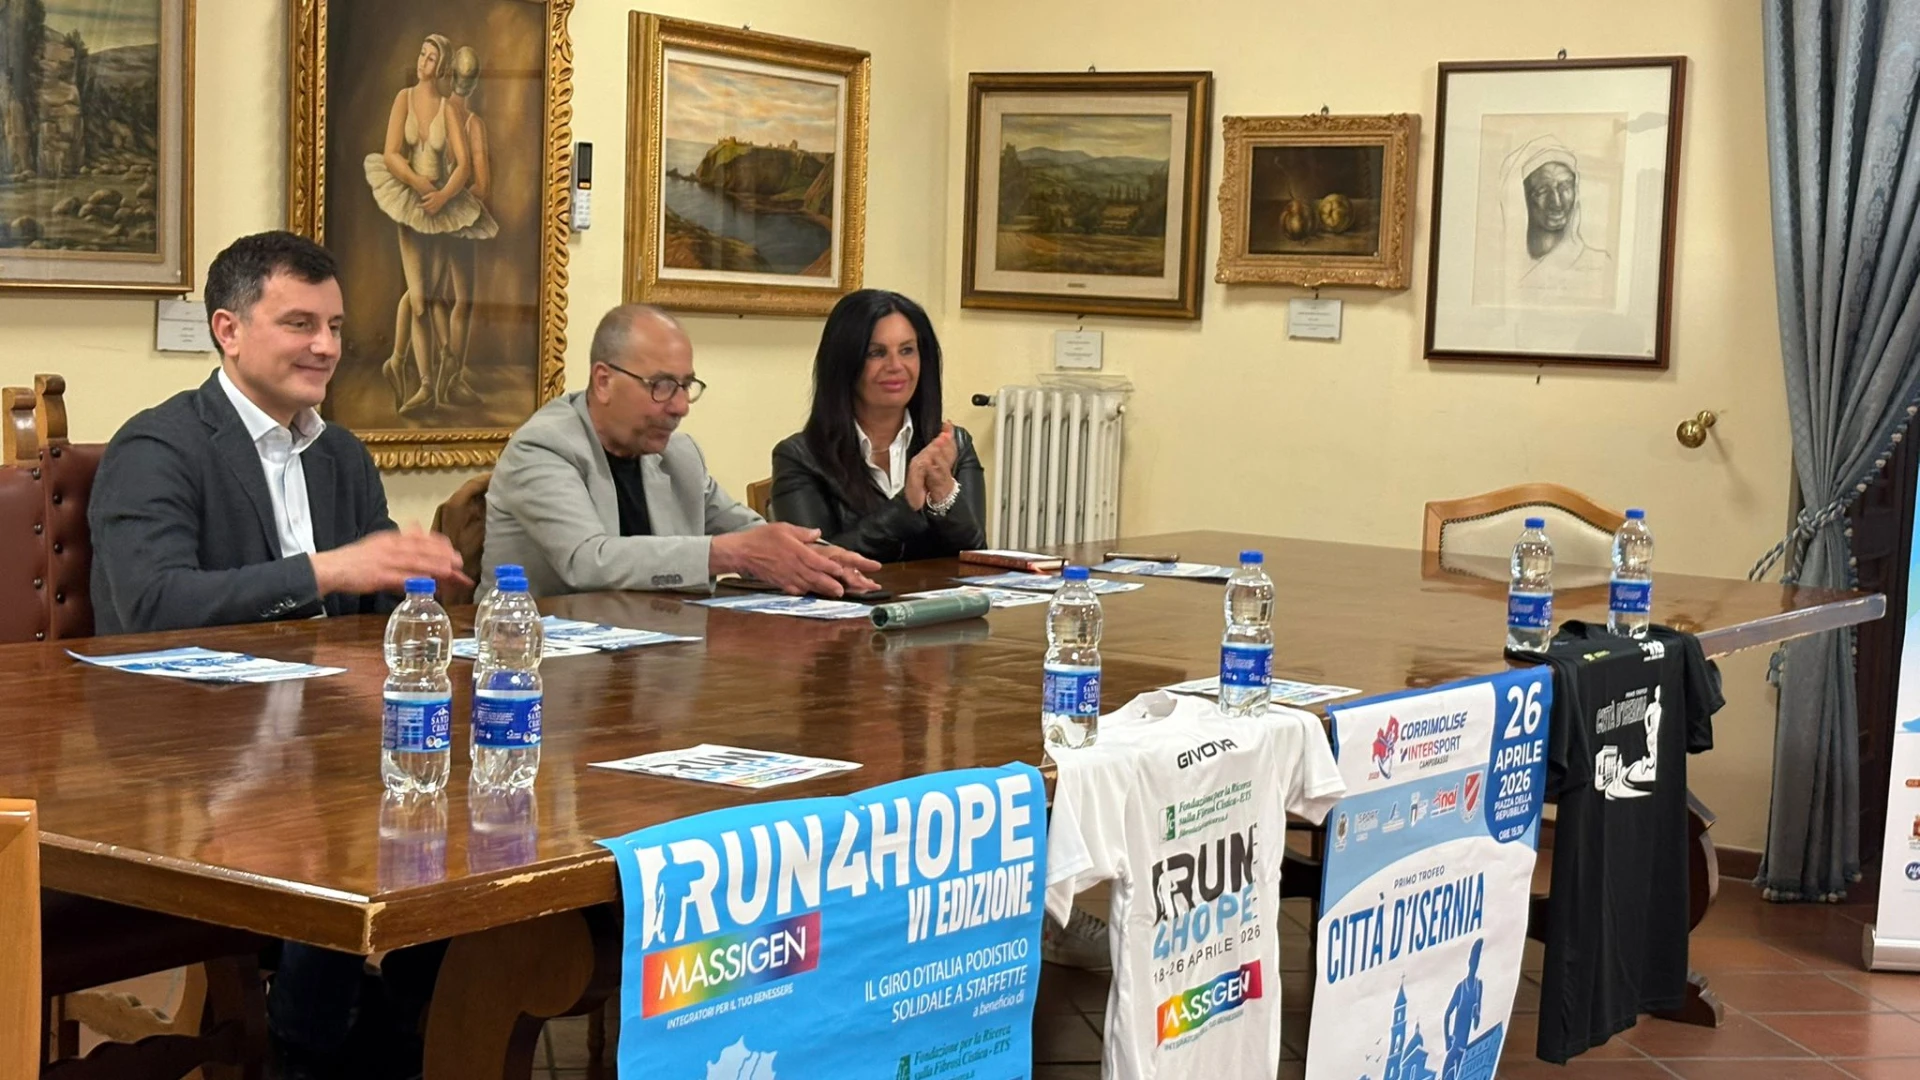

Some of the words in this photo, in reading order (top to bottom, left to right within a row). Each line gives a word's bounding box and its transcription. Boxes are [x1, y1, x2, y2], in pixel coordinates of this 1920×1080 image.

[1401, 711, 1468, 741] CORRIMOLISE
[1504, 681, 1543, 740] 26
[1177, 738, 1238, 769] GIVOVA
[1408, 735, 1461, 760] INTERSPORT
[1493, 739, 1543, 773] APRILE
[1499, 768, 1531, 798] 2026
[1495, 803, 1529, 821] REPUBBLICA
[1394, 873, 1416, 890] PRIMO
[1418, 865, 1445, 884] TROFEO
[908, 886, 930, 943] VI
[936, 860, 1034, 935] EDIZIONE
[1153, 883, 1254, 960] 4HOPE
[1327, 892, 1386, 985] CITTÀ
[1388, 872, 1485, 962] D'ISERNIA
[659, 926, 807, 1000] MASSIGEN
[865, 981, 876, 1002] IL
[879, 971, 911, 997] GIRO
[913, 956, 963, 988] D'ITALIA
[966, 938, 1028, 973] PODISTICO
[1154, 959, 1184, 985] 18-26
[1187, 937, 1233, 968] APRILE
[1241, 924, 1261, 944] 026
[667, 1006, 714, 1030] INTEGRATORI
[715, 1002, 730, 1015] PER
[730, 1000, 738, 1011] IL
[738, 995, 753, 1008] TUO
[753, 983, 794, 1005] BENESSERE
[892, 986, 952, 1023] SOLIDALE
[954, 983, 963, 1004] A
[965, 964, 1028, 1001] STAFFETTE
[972, 1006, 979, 1018] a
[980, 993, 1016, 1015] beneficio
[1016, 989, 1025, 1003] di
